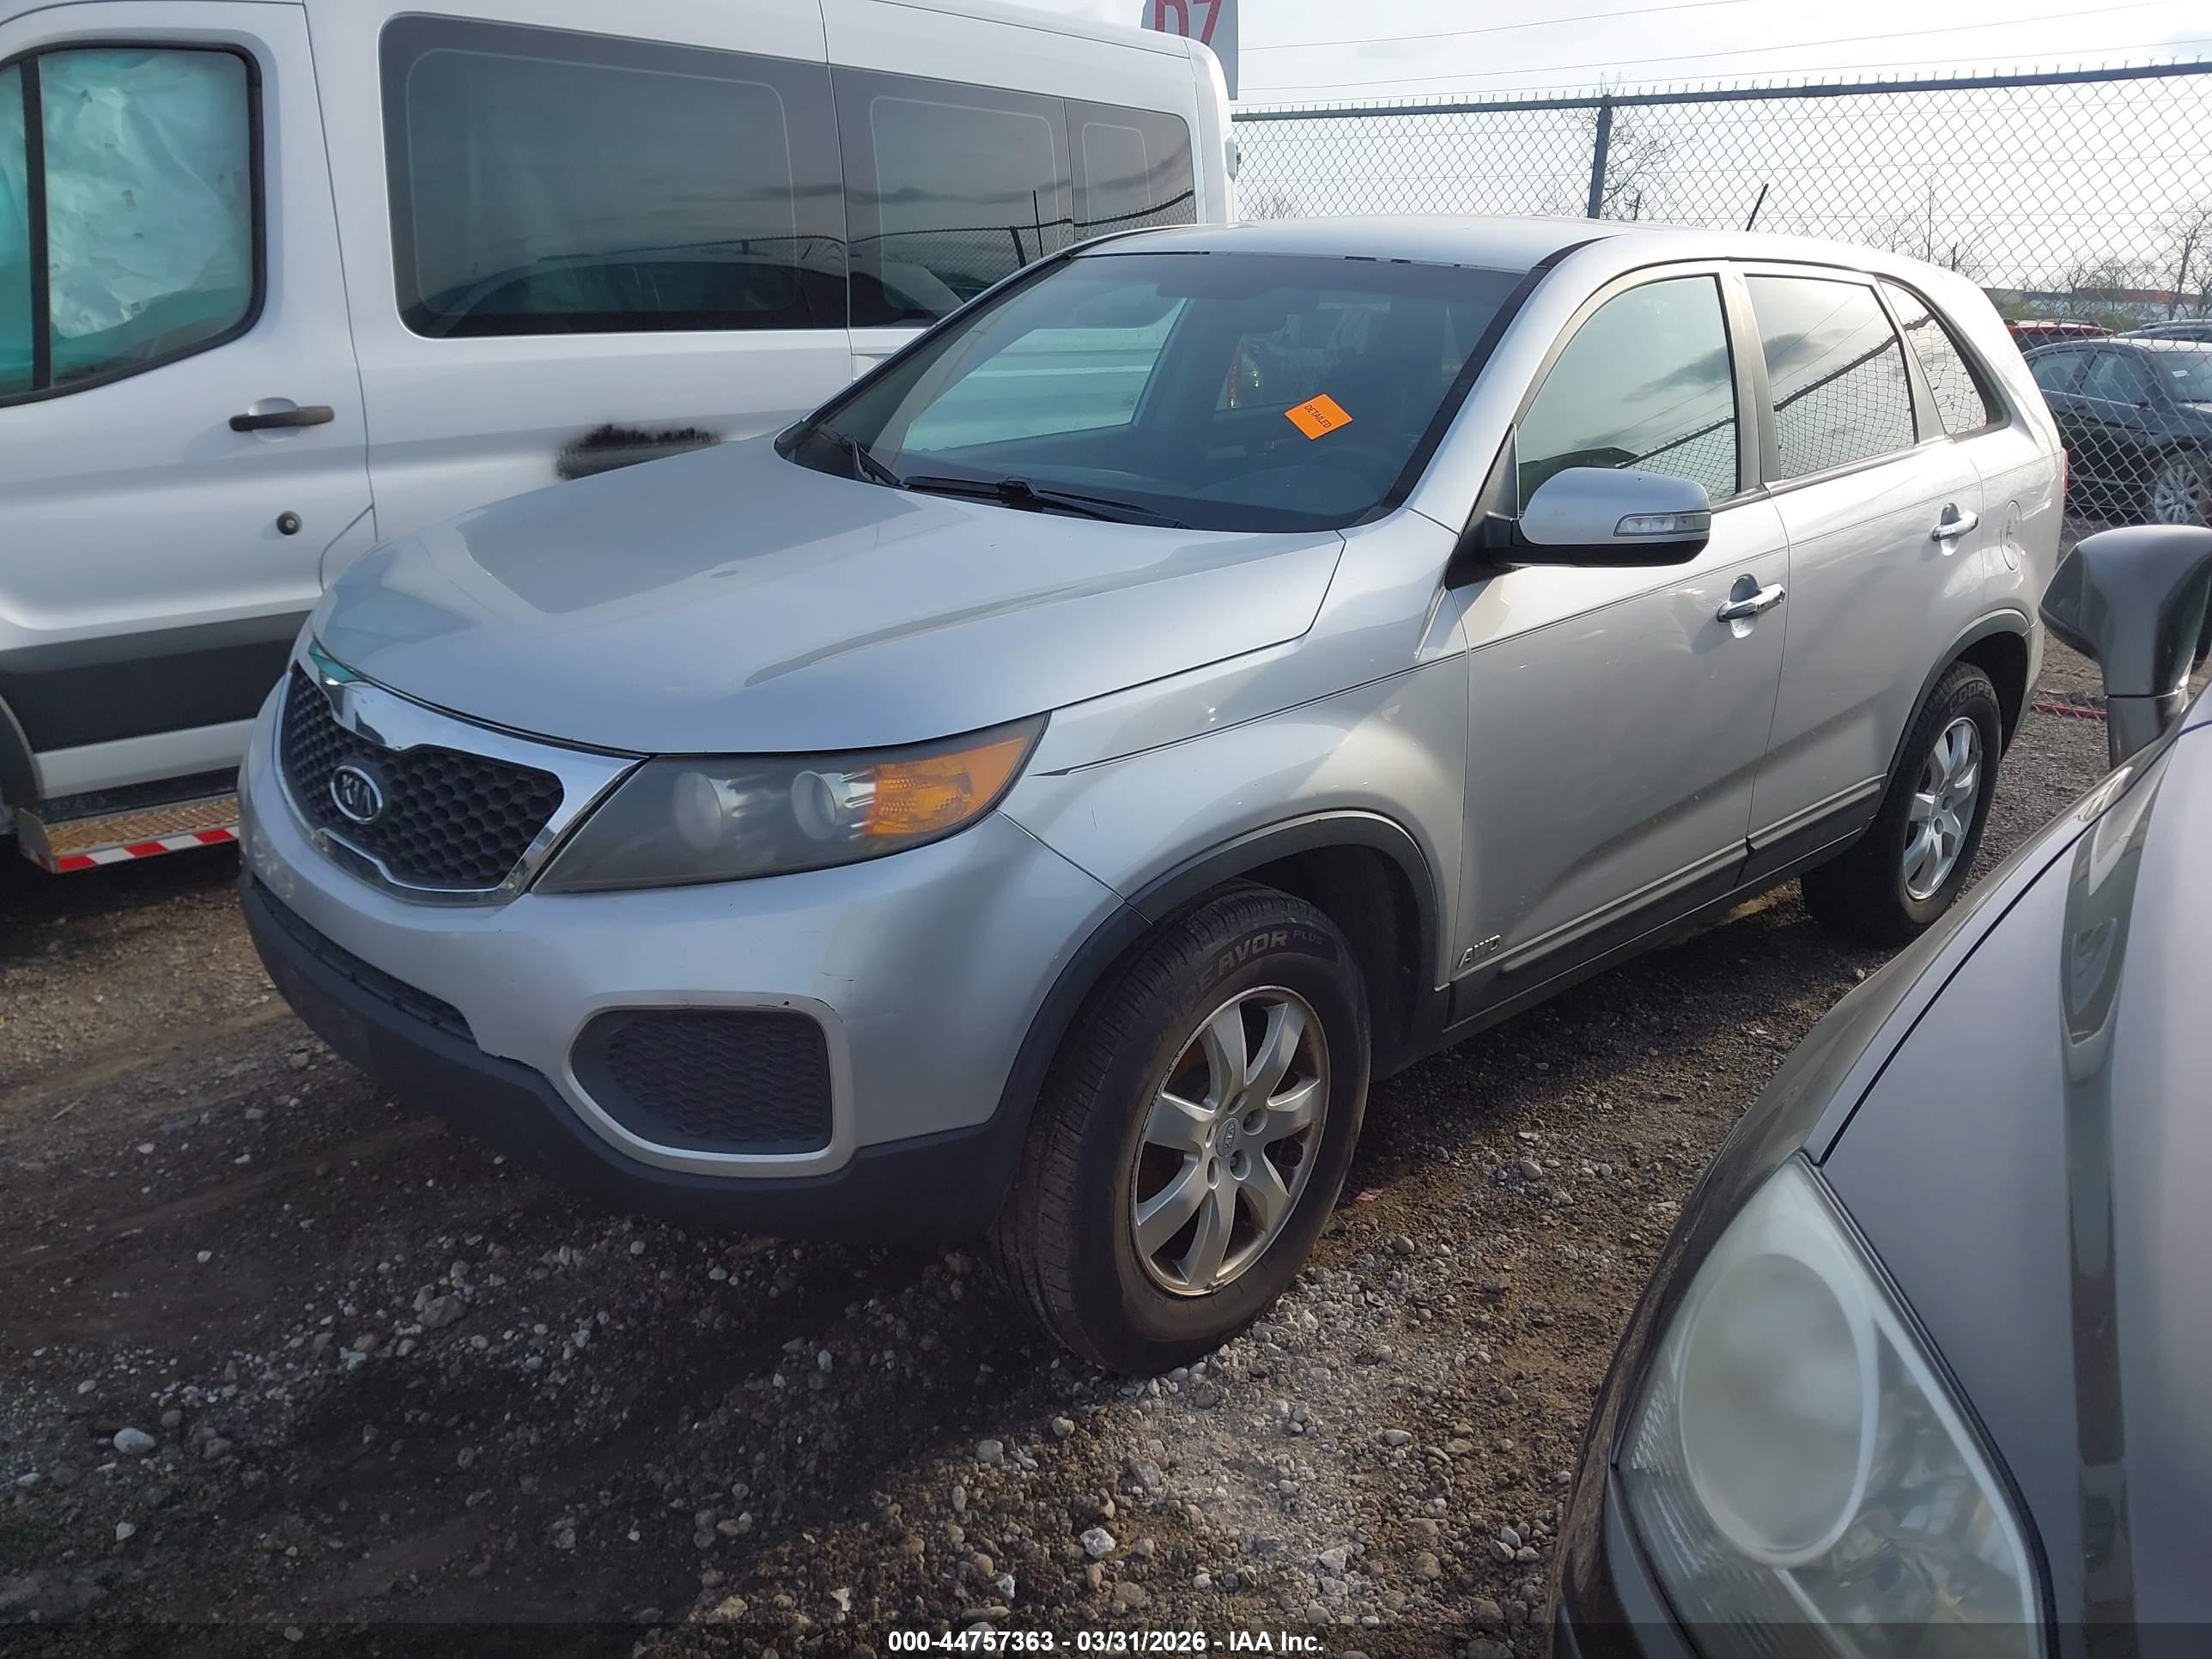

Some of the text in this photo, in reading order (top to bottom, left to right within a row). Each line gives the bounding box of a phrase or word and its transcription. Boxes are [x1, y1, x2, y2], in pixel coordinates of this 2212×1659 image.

[1304, 404, 1332, 428] DETAILED
[343, 774, 373, 815] KIA
[1292, 929, 1324, 946] PLUS
